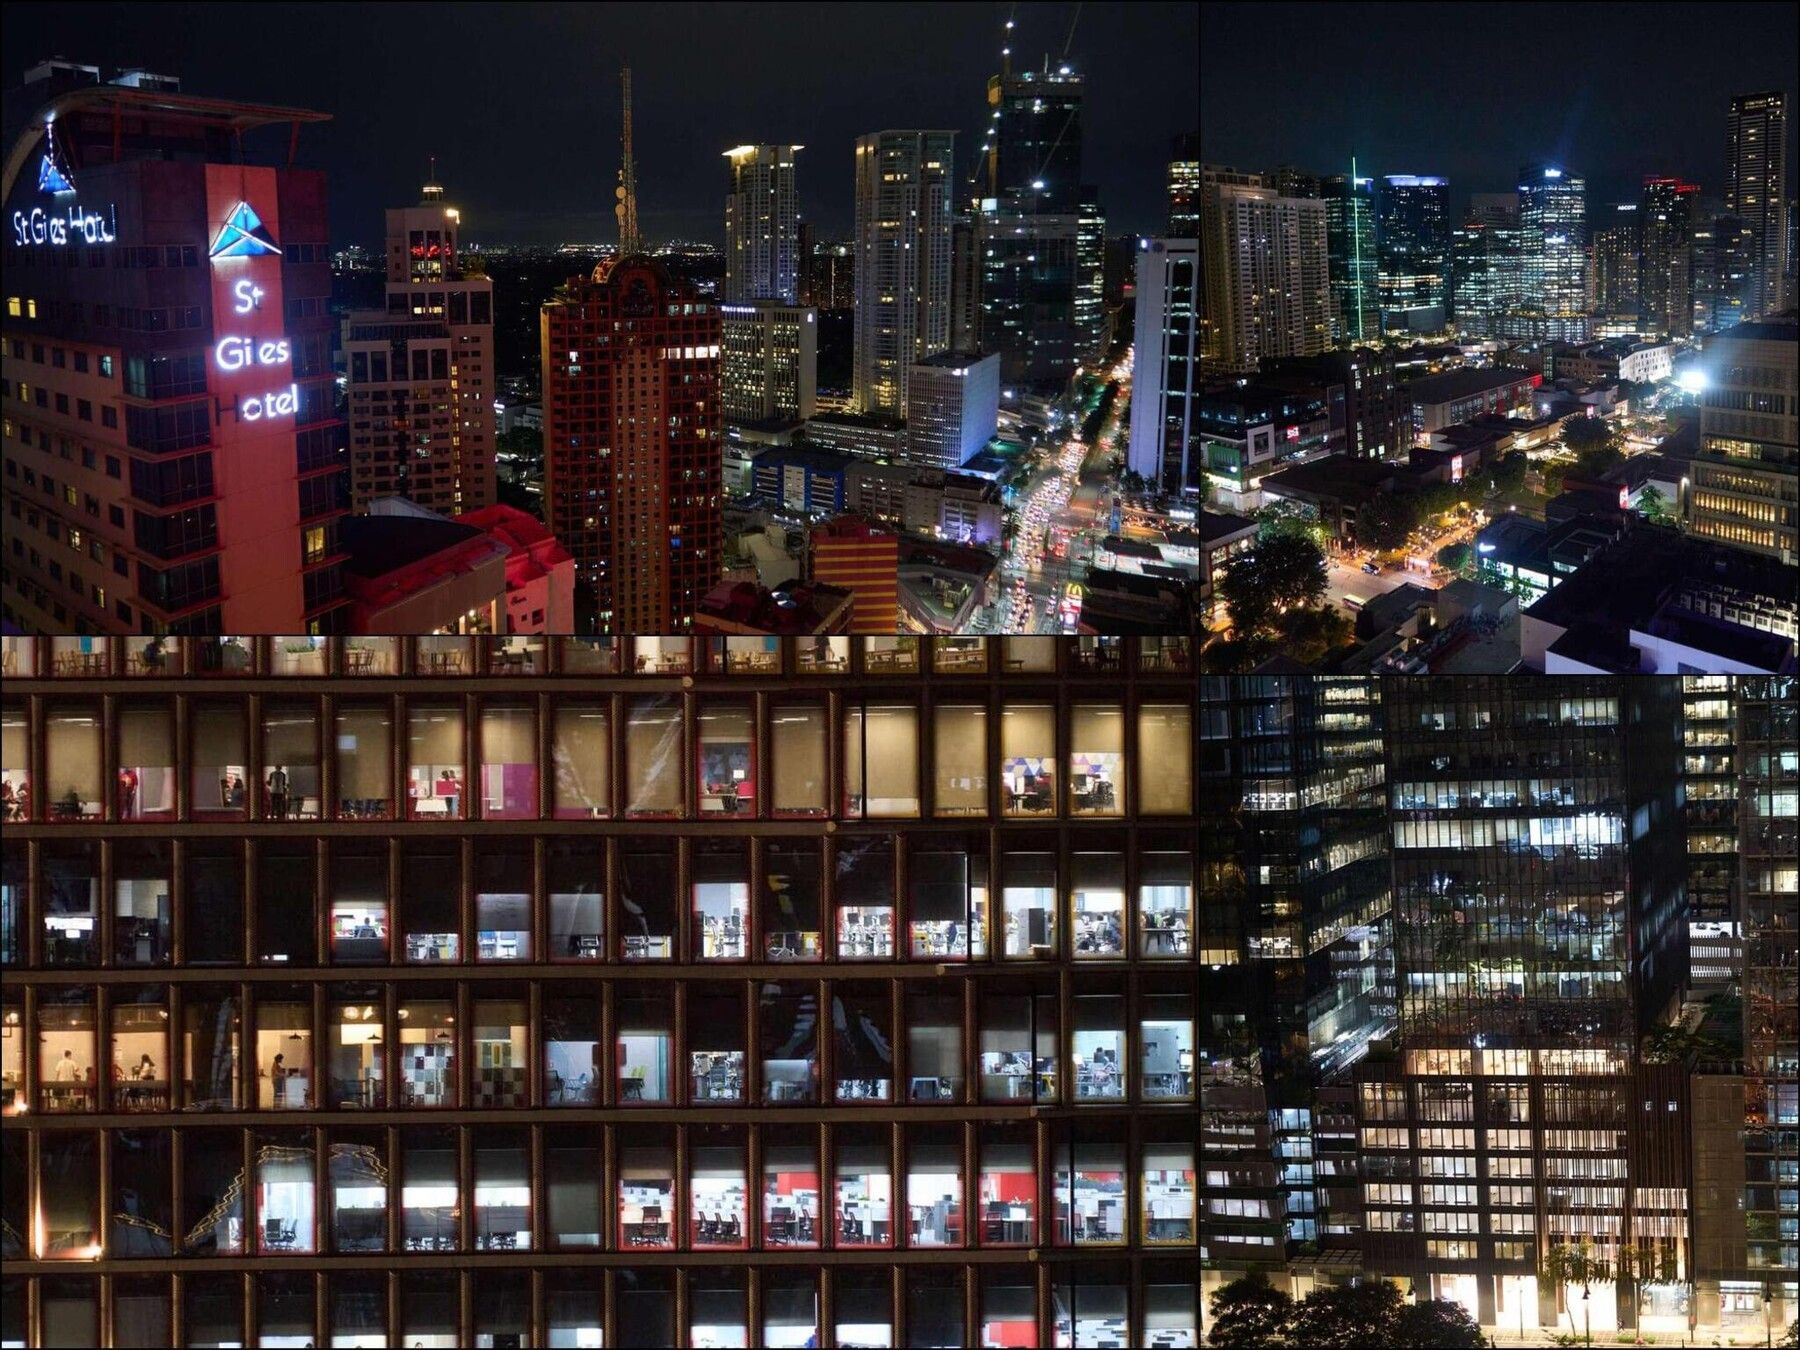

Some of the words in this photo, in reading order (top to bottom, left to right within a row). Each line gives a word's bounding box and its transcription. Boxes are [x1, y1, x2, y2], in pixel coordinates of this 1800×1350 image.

[14, 211, 30, 246] St
[31, 207, 67, 245] Gies
[234, 280, 264, 313] St
